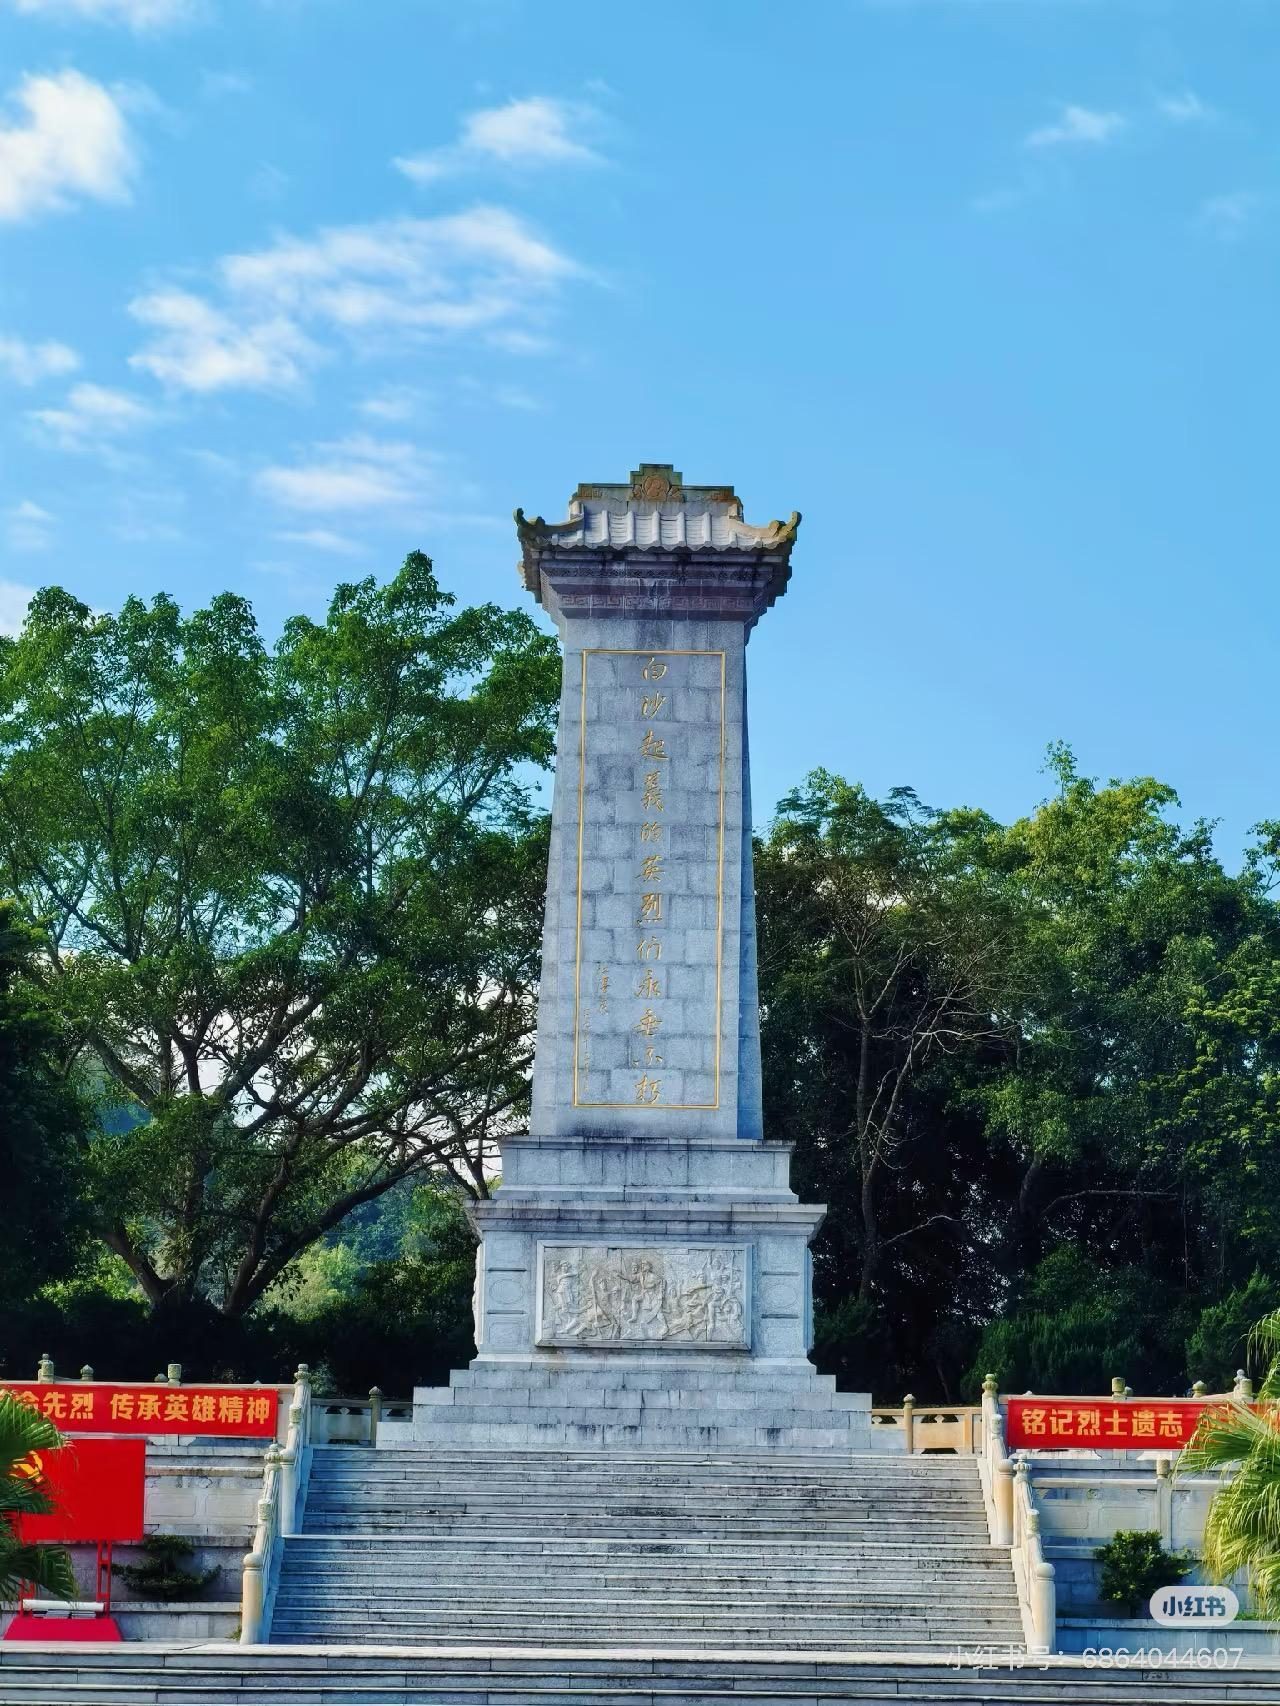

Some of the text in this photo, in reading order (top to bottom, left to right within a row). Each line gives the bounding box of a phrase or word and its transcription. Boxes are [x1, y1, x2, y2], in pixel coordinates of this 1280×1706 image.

[110, 1394, 270, 1424] 传承英雄精神
[1021, 1408, 1183, 1437] 铭记烈士遗志
